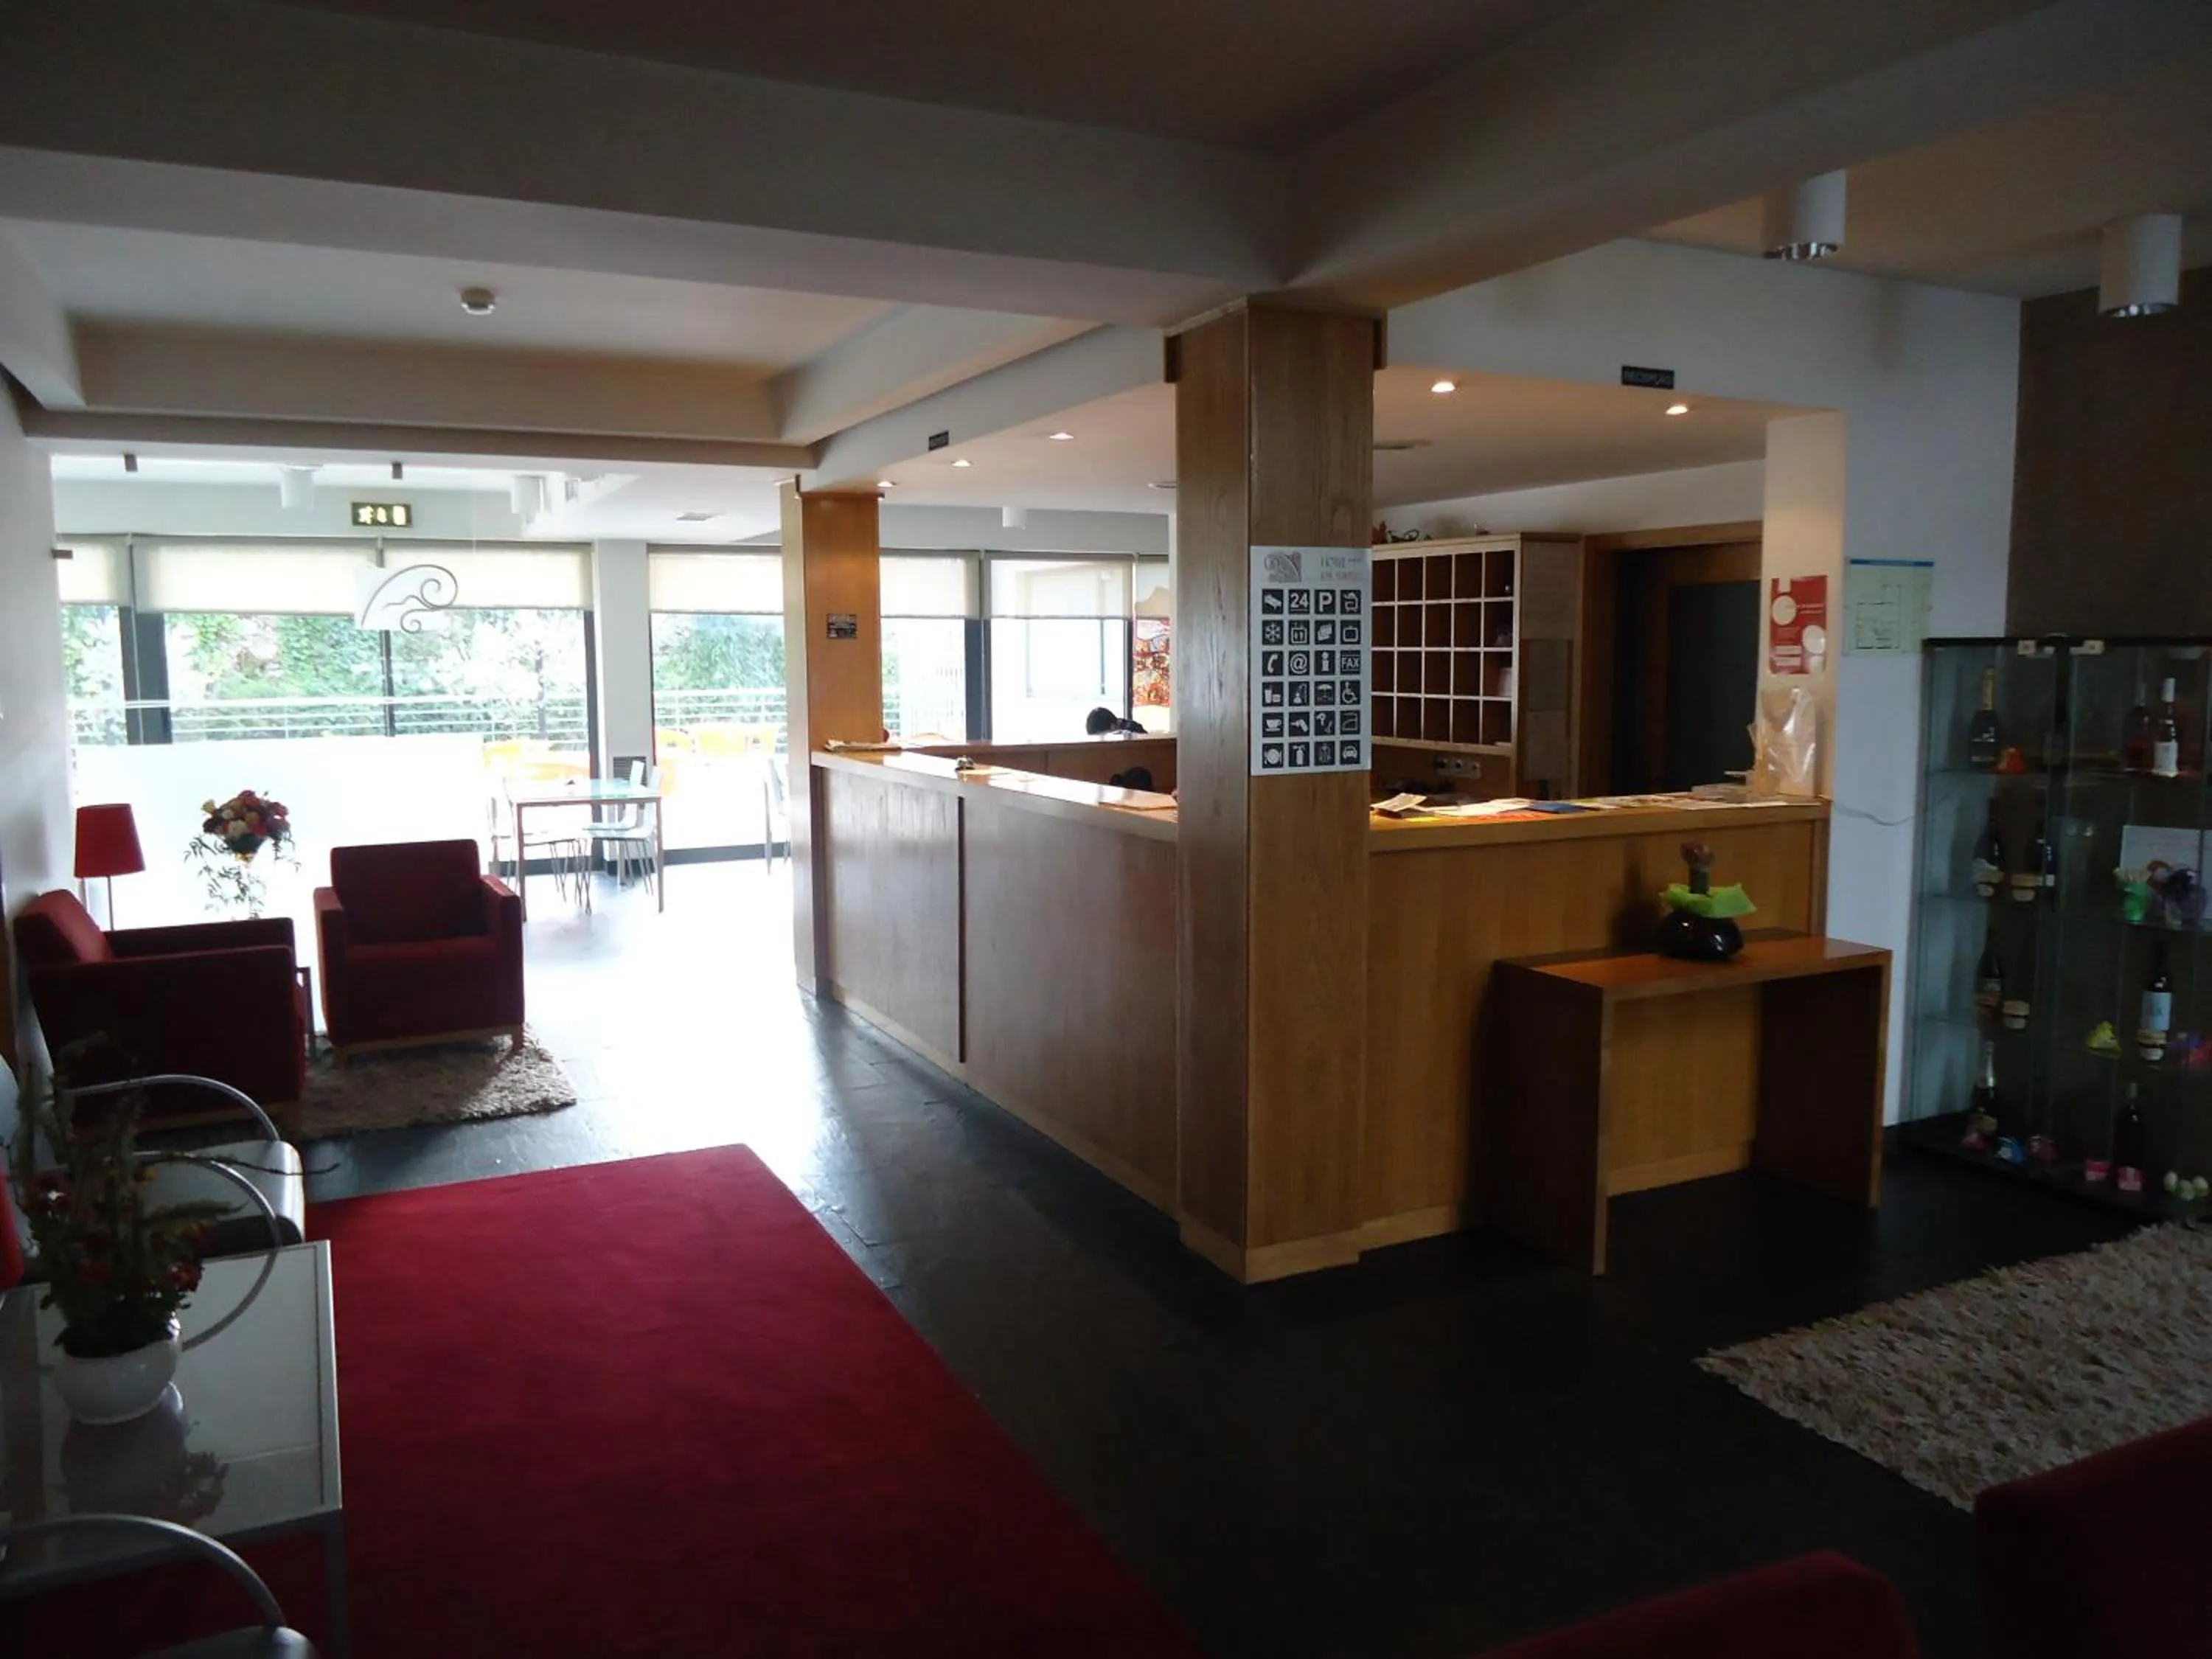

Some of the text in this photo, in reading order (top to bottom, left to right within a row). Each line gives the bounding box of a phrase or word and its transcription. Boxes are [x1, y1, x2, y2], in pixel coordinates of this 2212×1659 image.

[1290, 592, 1308, 608] 24
[1319, 592, 1333, 612] P
[1342, 657, 1359, 669] FAX
